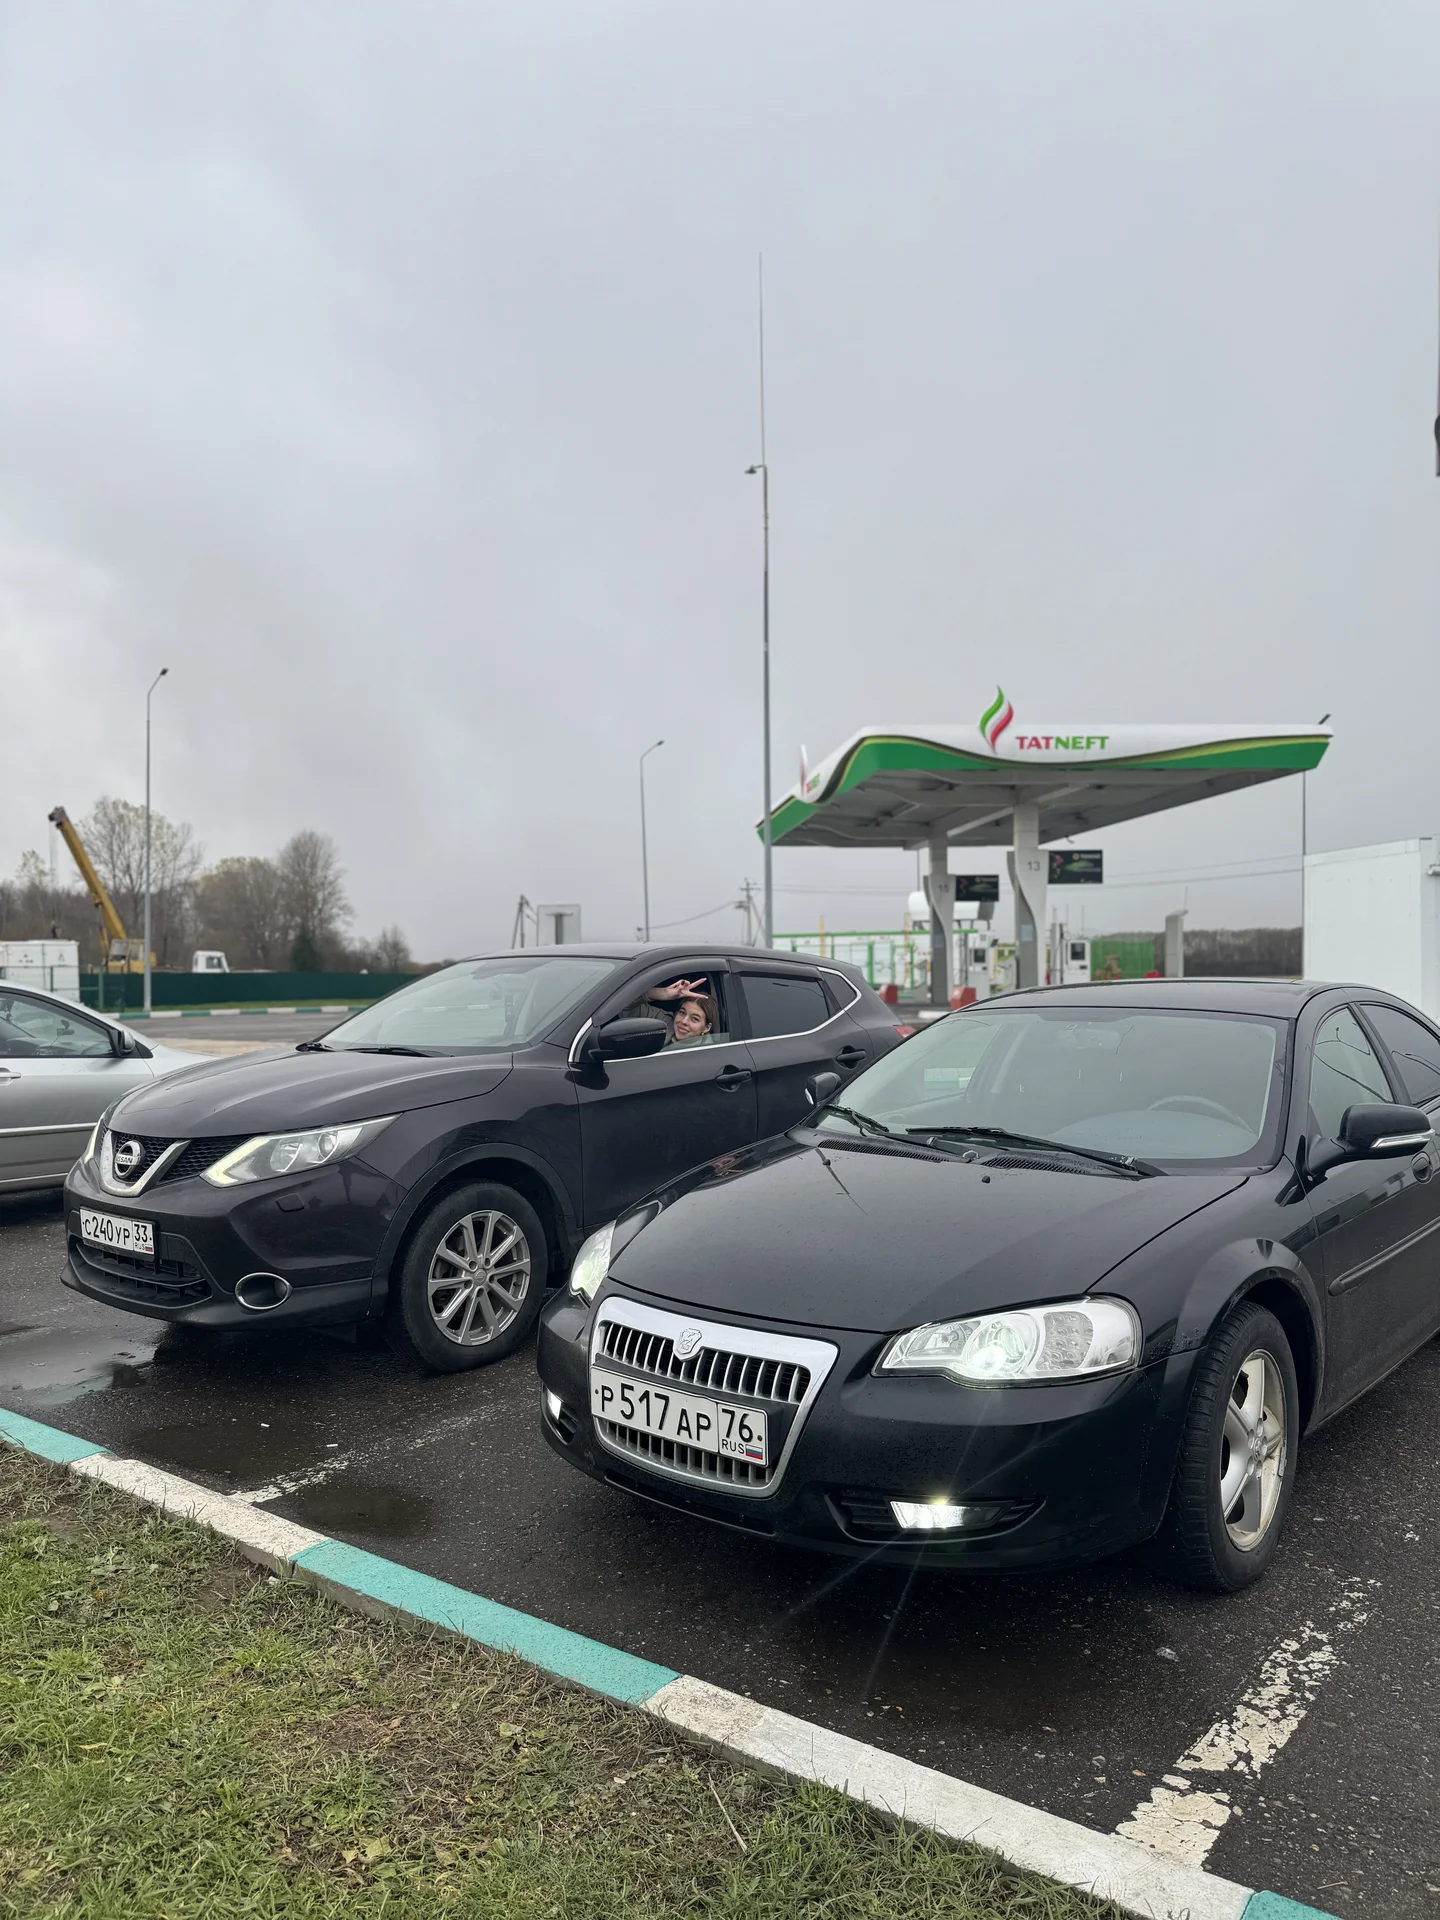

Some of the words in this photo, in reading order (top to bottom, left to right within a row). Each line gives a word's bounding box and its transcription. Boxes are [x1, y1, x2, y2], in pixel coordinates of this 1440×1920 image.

[1015, 736, 1110, 750] TATNEFT
[1027, 860, 1041, 872] 13
[134, 1223, 148, 1243] 33
[721, 1408, 754, 1443] 76
[721, 1439, 746, 1455] RUS
